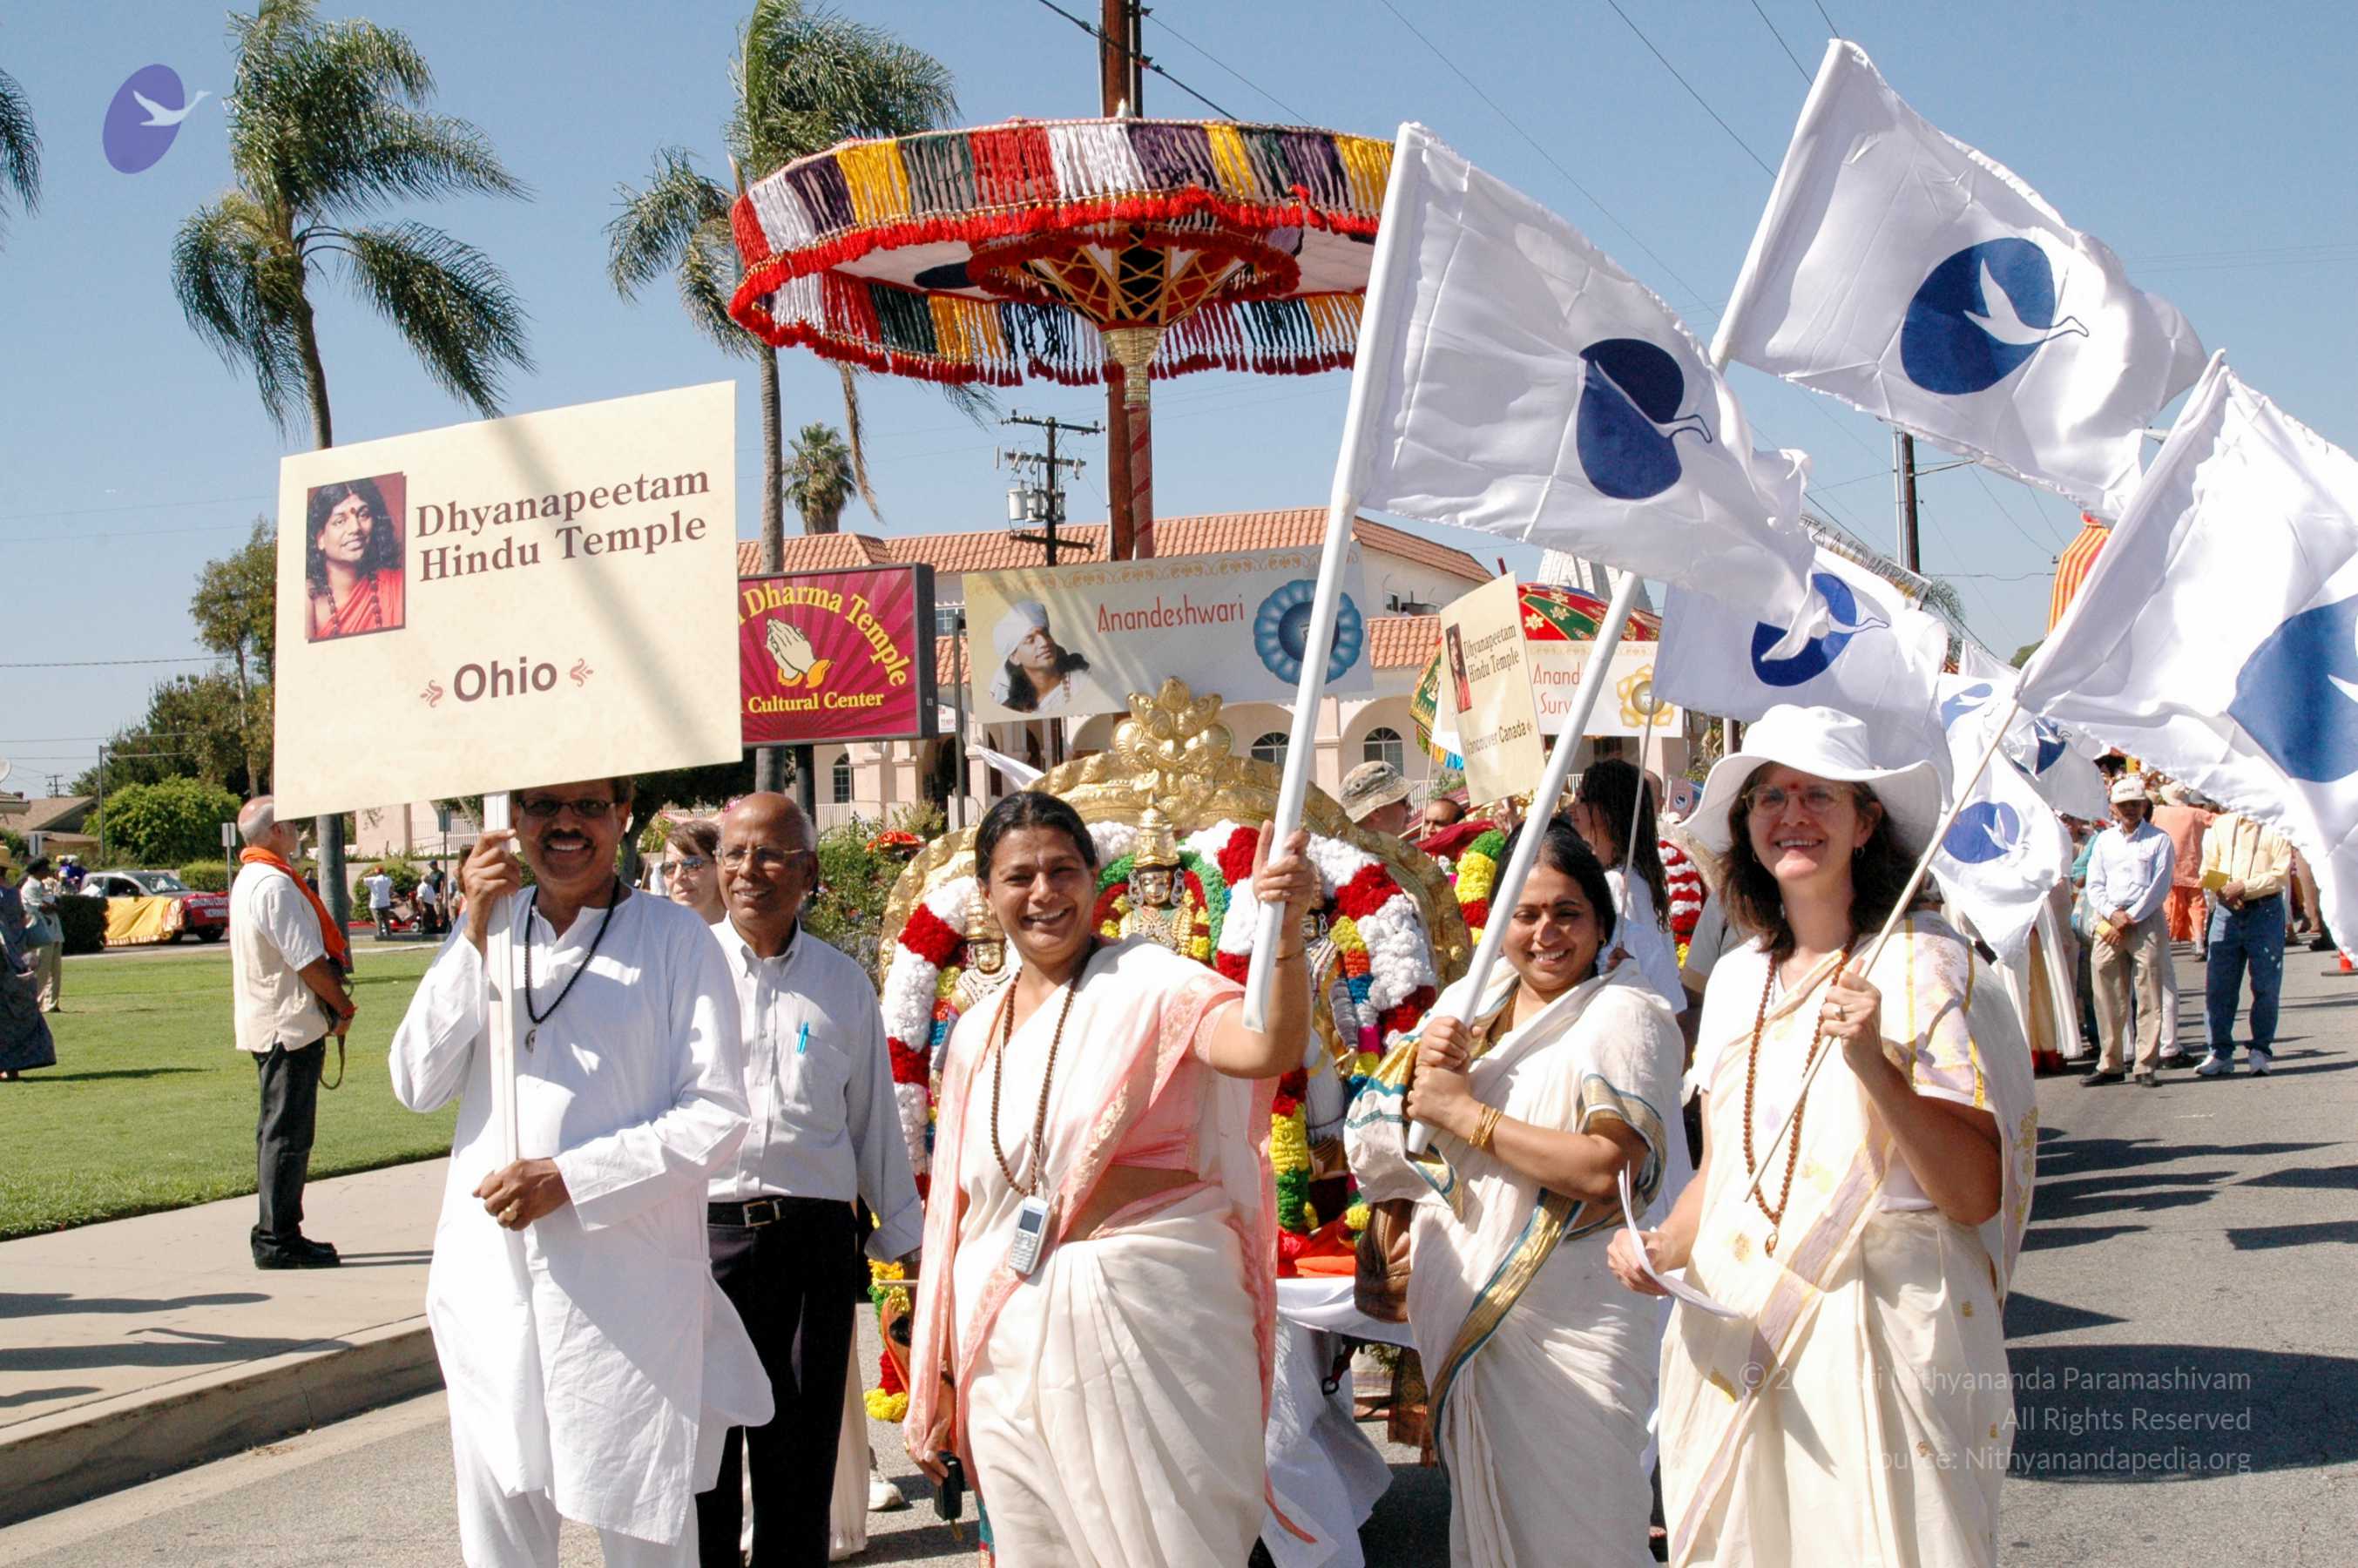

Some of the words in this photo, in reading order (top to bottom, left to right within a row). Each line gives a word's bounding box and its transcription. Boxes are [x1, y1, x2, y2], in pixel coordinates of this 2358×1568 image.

[415, 470, 710, 538] Dhyanapeetam
[419, 536, 541, 582] Hindu
[555, 510, 707, 560] Temple
[1097, 593, 1245, 634] Anandeshwari
[742, 582, 844, 618] Dharma
[845, 593, 911, 687] Temple
[1463, 625, 1517, 659] Dhyanapeetam
[453, 656, 557, 703] Ohio
[1468, 659, 1490, 684] Hindu
[1490, 646, 1520, 672] Temple
[1533, 661, 1583, 686] Anand
[747, 693, 820, 713] Cultural
[823, 691, 885, 709] Center
[1539, 692, 1572, 714] Surv
[1498, 719, 1527, 743] Canada
